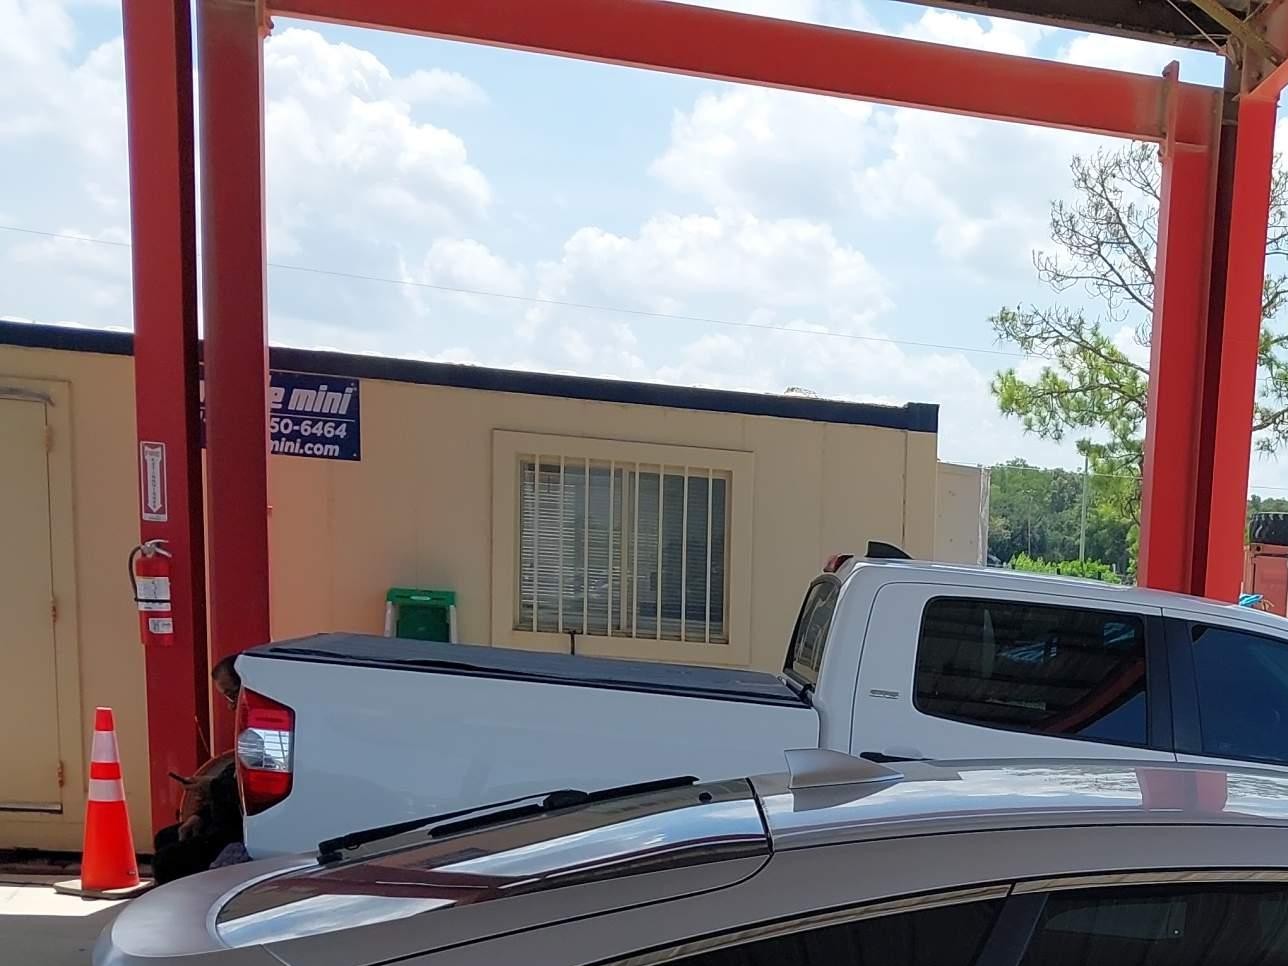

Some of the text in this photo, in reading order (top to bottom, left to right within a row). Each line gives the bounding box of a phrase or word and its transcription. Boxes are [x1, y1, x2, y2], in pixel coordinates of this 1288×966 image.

[288, 385, 352, 415] mini
[270, 418, 347, 439] 50-6464
[270, 437, 340, 457] mini.com
